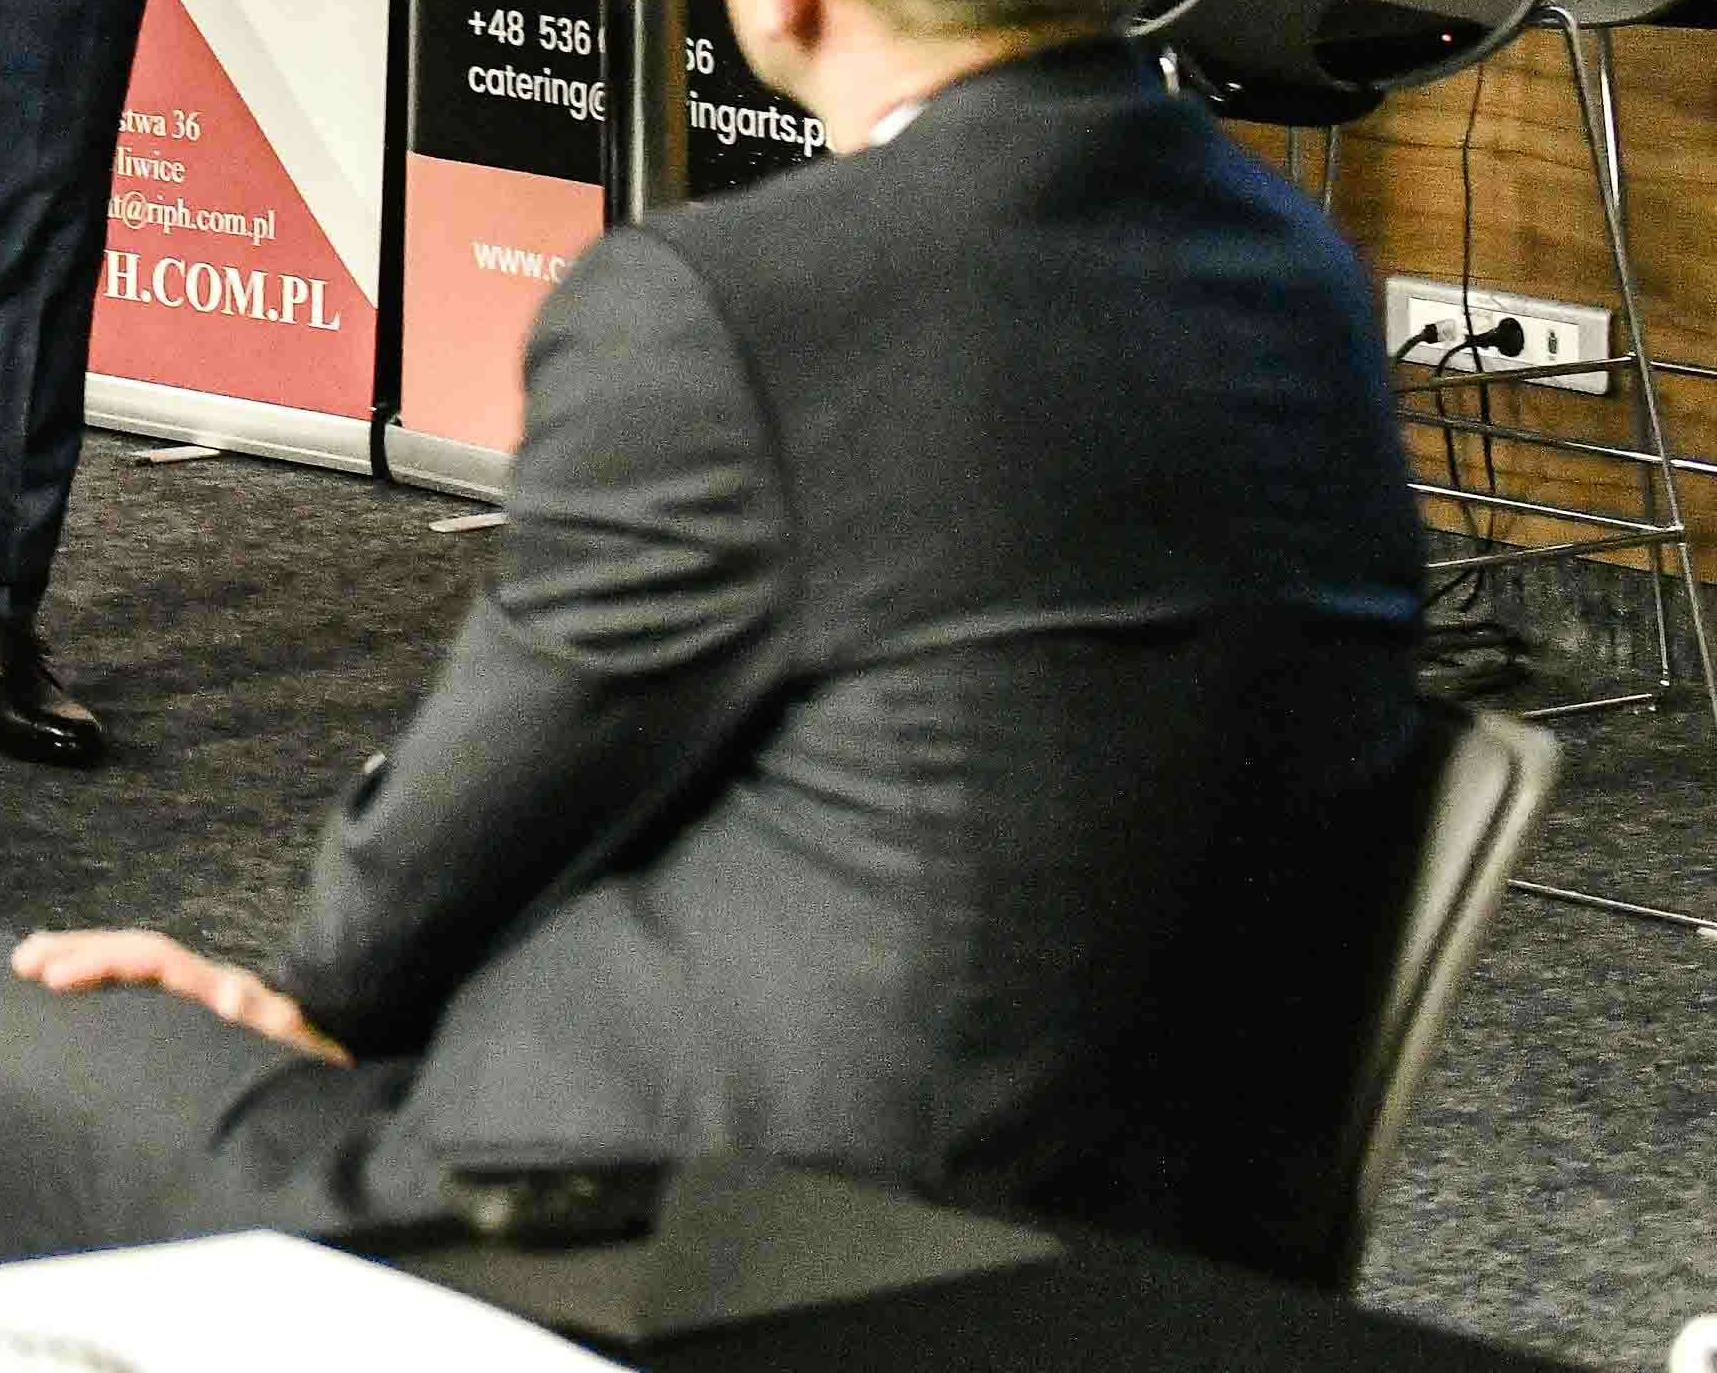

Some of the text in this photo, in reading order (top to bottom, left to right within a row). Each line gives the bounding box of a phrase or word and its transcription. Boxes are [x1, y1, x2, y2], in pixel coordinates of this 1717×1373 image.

[467, 8, 526, 48] +48
[538, 14, 592, 56] 536
[171, 109, 202, 142] 36
[117, 146, 186, 184] liwice
